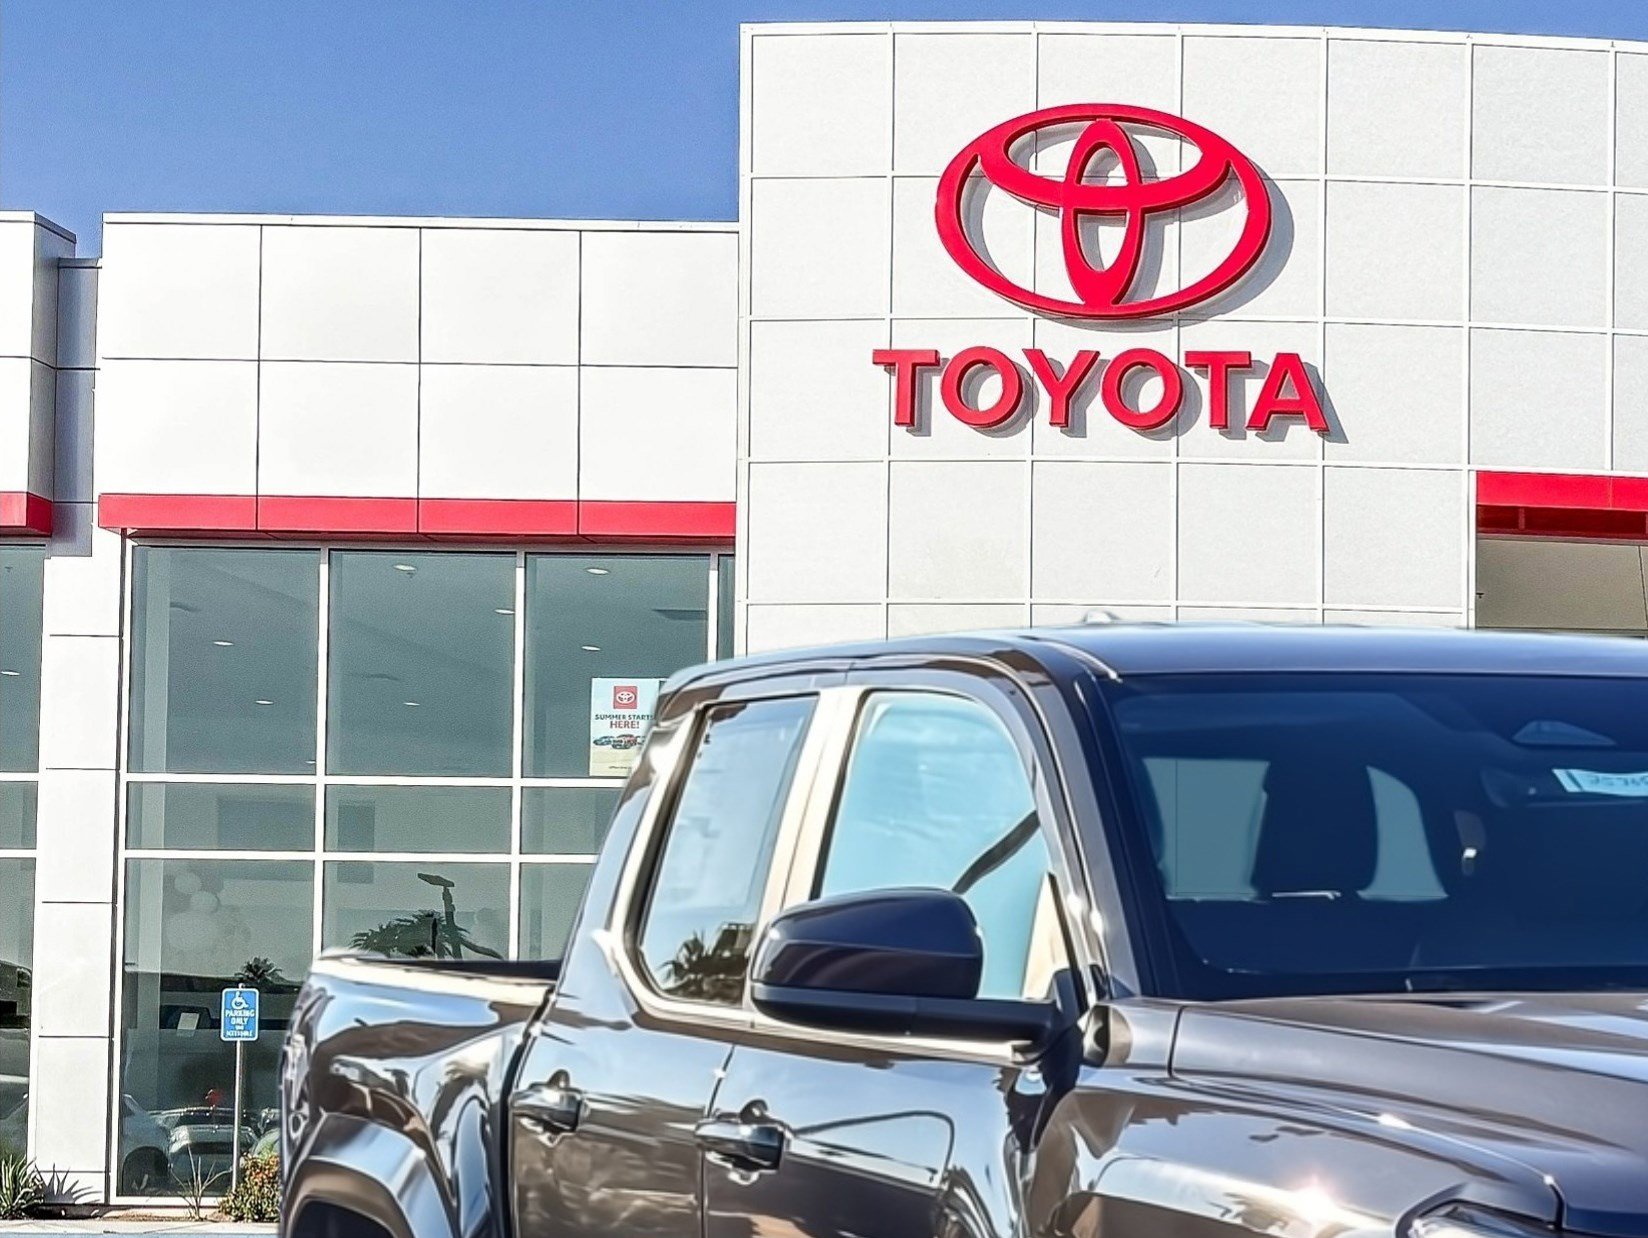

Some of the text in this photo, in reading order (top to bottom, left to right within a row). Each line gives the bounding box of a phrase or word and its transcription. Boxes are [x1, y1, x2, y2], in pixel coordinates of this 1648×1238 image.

[872, 345, 1329, 432] TOYOTA
[610, 721, 640, 729] HERE!
[225, 1009, 255, 1017] PARKING
[231, 1017, 249, 1025] ONLY
